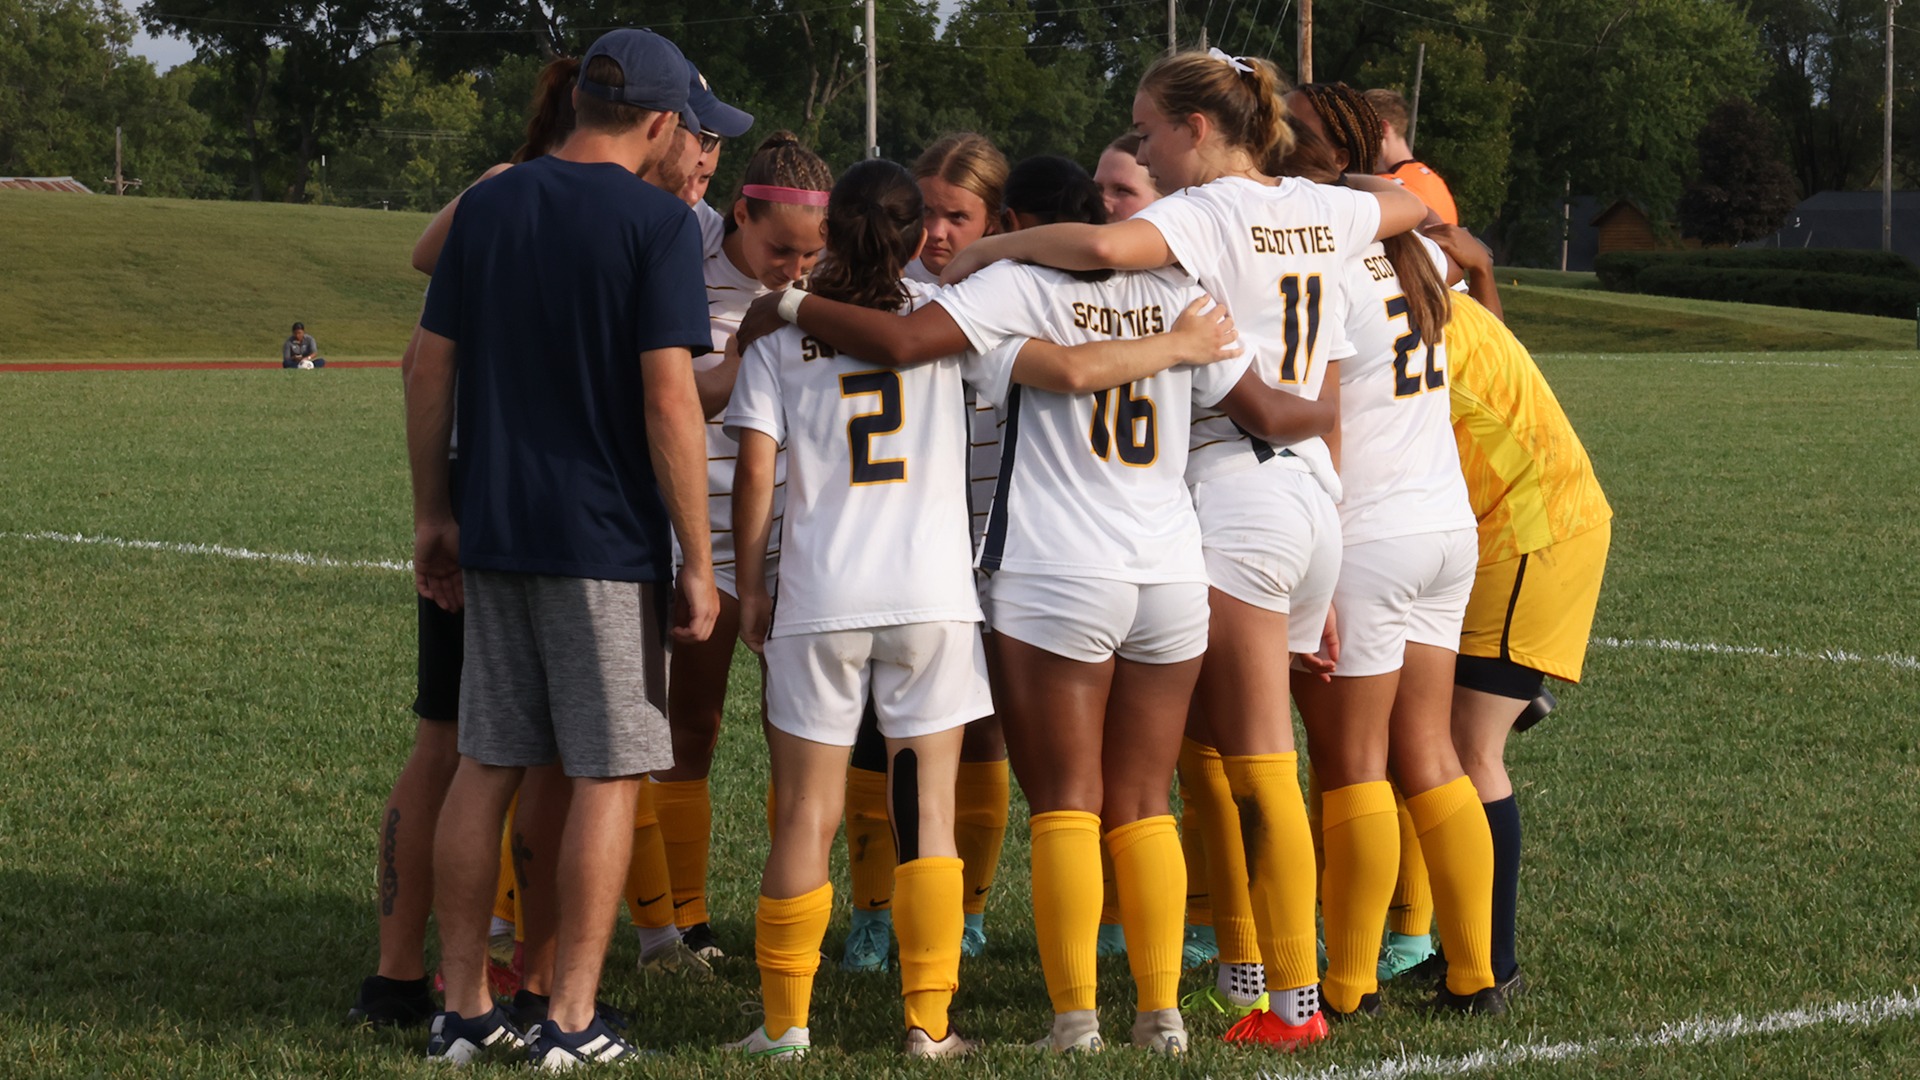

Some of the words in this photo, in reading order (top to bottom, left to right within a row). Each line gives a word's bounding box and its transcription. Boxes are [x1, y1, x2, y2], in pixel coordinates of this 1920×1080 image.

[1251, 225, 1335, 256] SCOTTIES
[1072, 301, 1165, 337] SCOTTIES
[1278, 272, 1322, 385] 11
[838, 368, 908, 487] 2
[1088, 374, 1159, 468] 16
